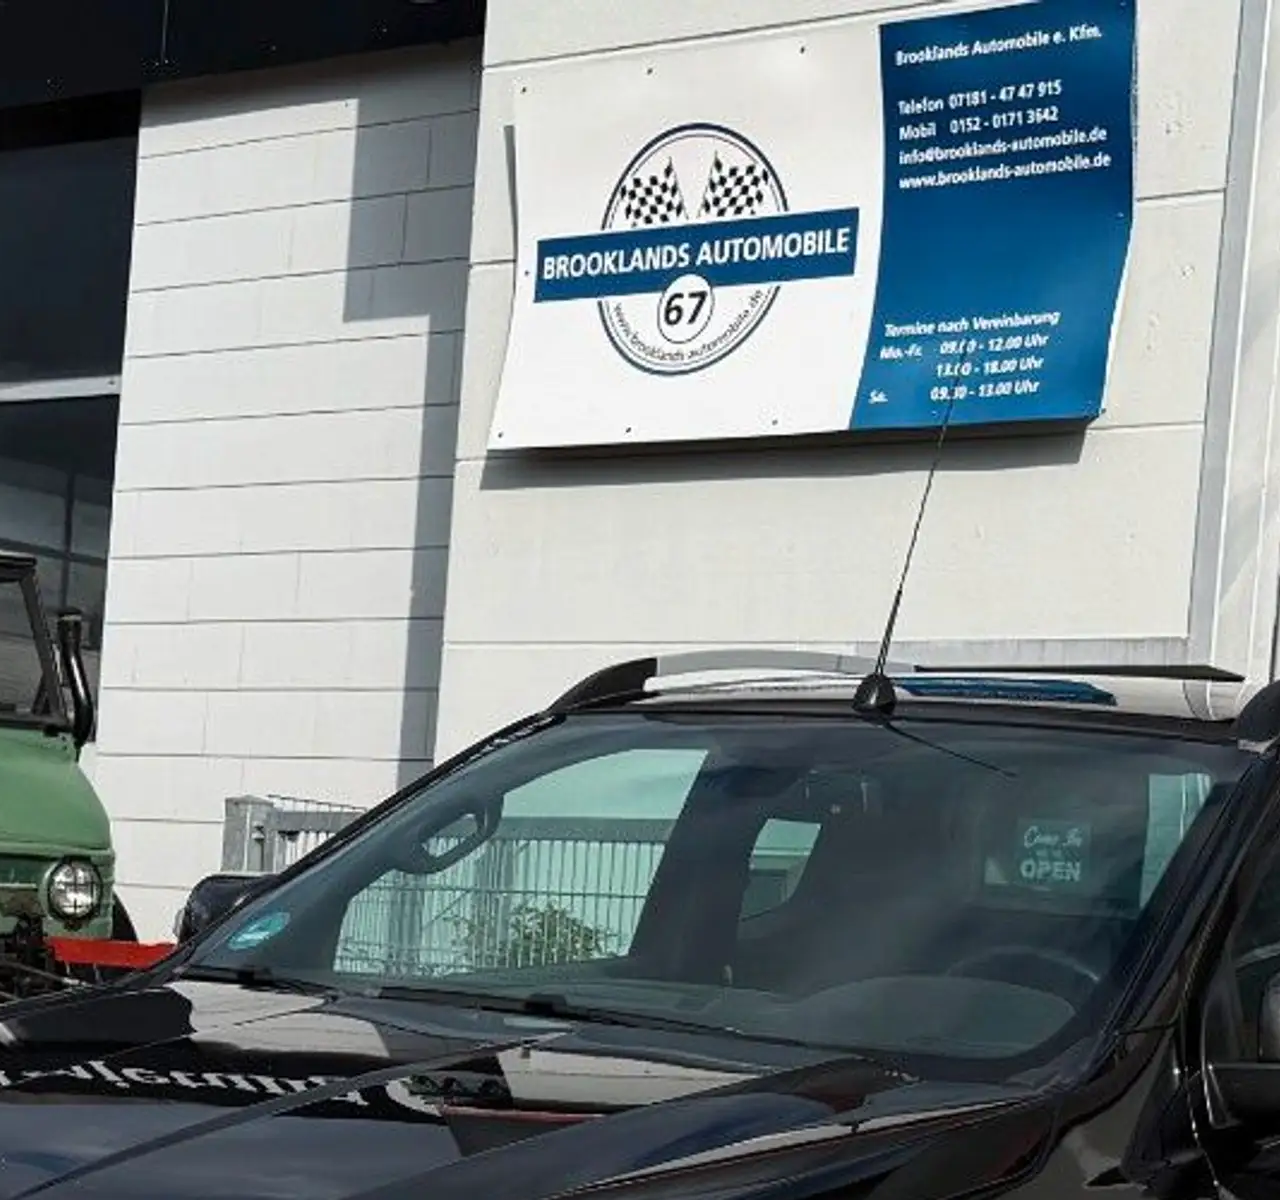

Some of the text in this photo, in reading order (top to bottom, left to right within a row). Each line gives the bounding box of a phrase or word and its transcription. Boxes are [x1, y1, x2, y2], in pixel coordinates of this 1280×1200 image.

[895, 24, 1103, 67] Brooklands Automobile e. Kfm.
[898, 96, 945, 115] Telefon
[948, 90, 988, 109] 07181
[999, 86, 1016, 102] 47
[1017, 83, 1036, 99] 47
[1038, 79, 1062, 97] 915
[898, 121, 937, 141] Mobil
[950, 116, 982, 134] 0152
[992, 110, 1023, 129] 0171
[898, 152, 1112, 189] www.brooklands-automobile.de
[542, 227, 850, 280] BROOKLANDS AUTOMOBILE
[663, 290, 708, 326] 67
[884, 312, 1061, 337] Termine nach Vereinbarung
[1024, 333, 1049, 348] Uhr
[1019, 356, 1044, 371] Uhr
[1014, 379, 1040, 395] Uhr
[1020, 858, 1081, 882] OPEN
